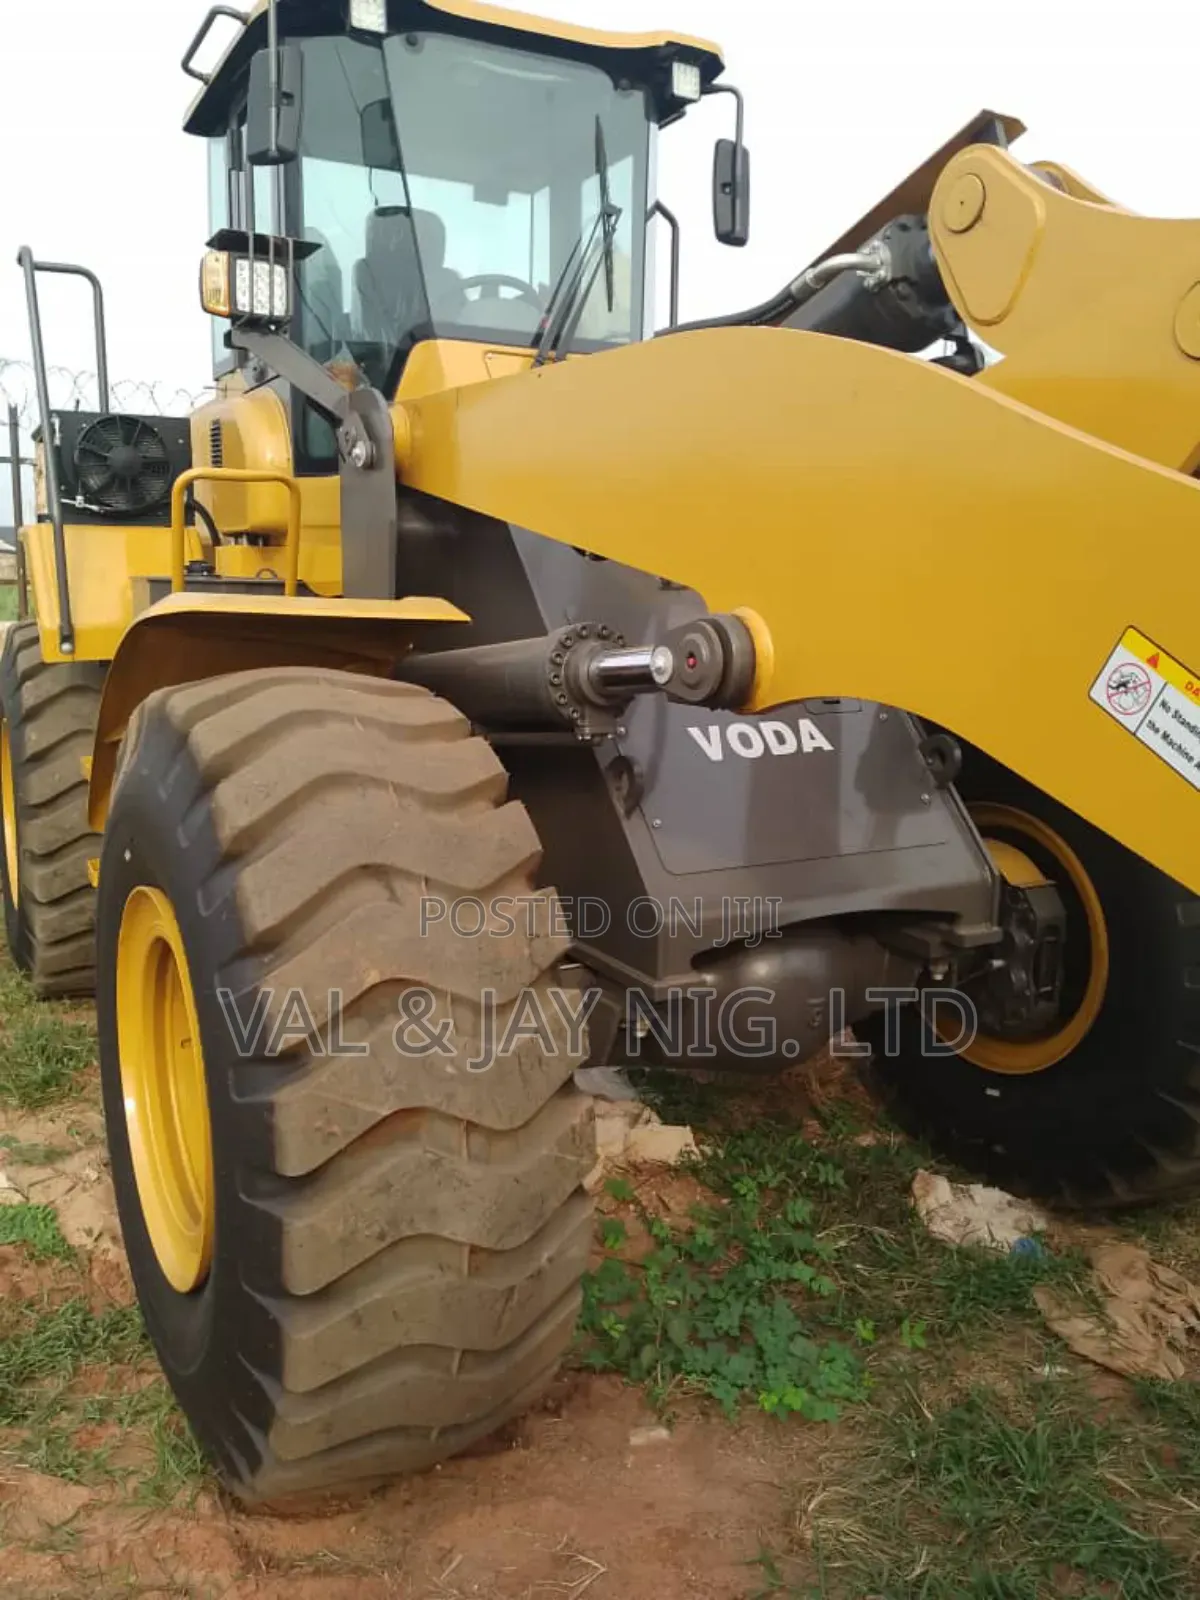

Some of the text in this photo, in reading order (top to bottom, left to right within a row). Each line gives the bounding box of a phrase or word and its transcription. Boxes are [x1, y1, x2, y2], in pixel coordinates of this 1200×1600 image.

[1159, 698, 1171, 714] No
[686, 718, 835, 761] VODA
[1146, 719, 1195, 763] the Machine
